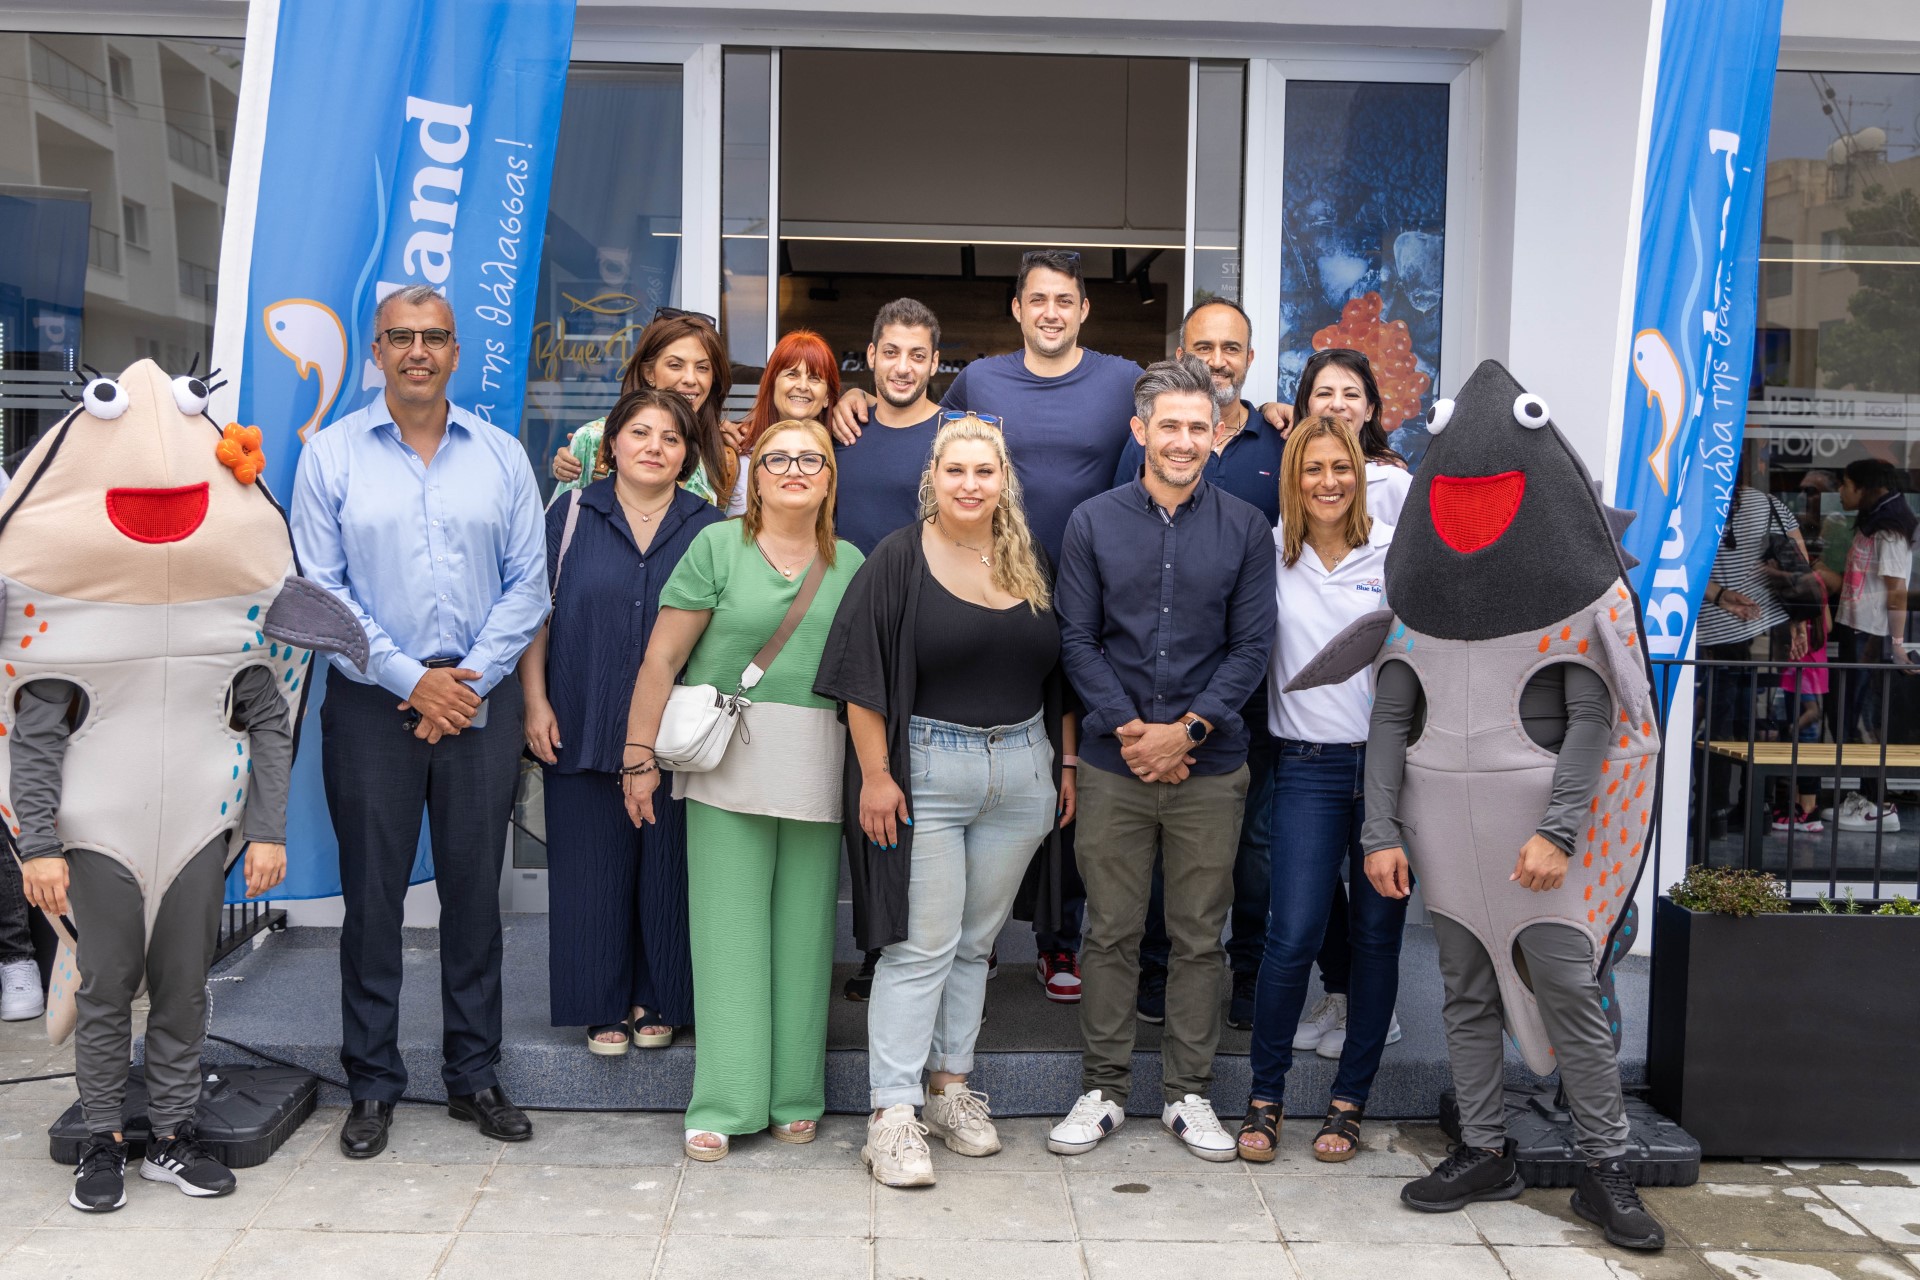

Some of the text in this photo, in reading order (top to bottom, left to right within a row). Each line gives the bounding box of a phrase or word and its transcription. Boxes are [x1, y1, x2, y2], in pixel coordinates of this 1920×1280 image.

[481, 338, 511, 391] της
[533, 316, 601, 380] Blue
[1713, 358, 1740, 406] της
